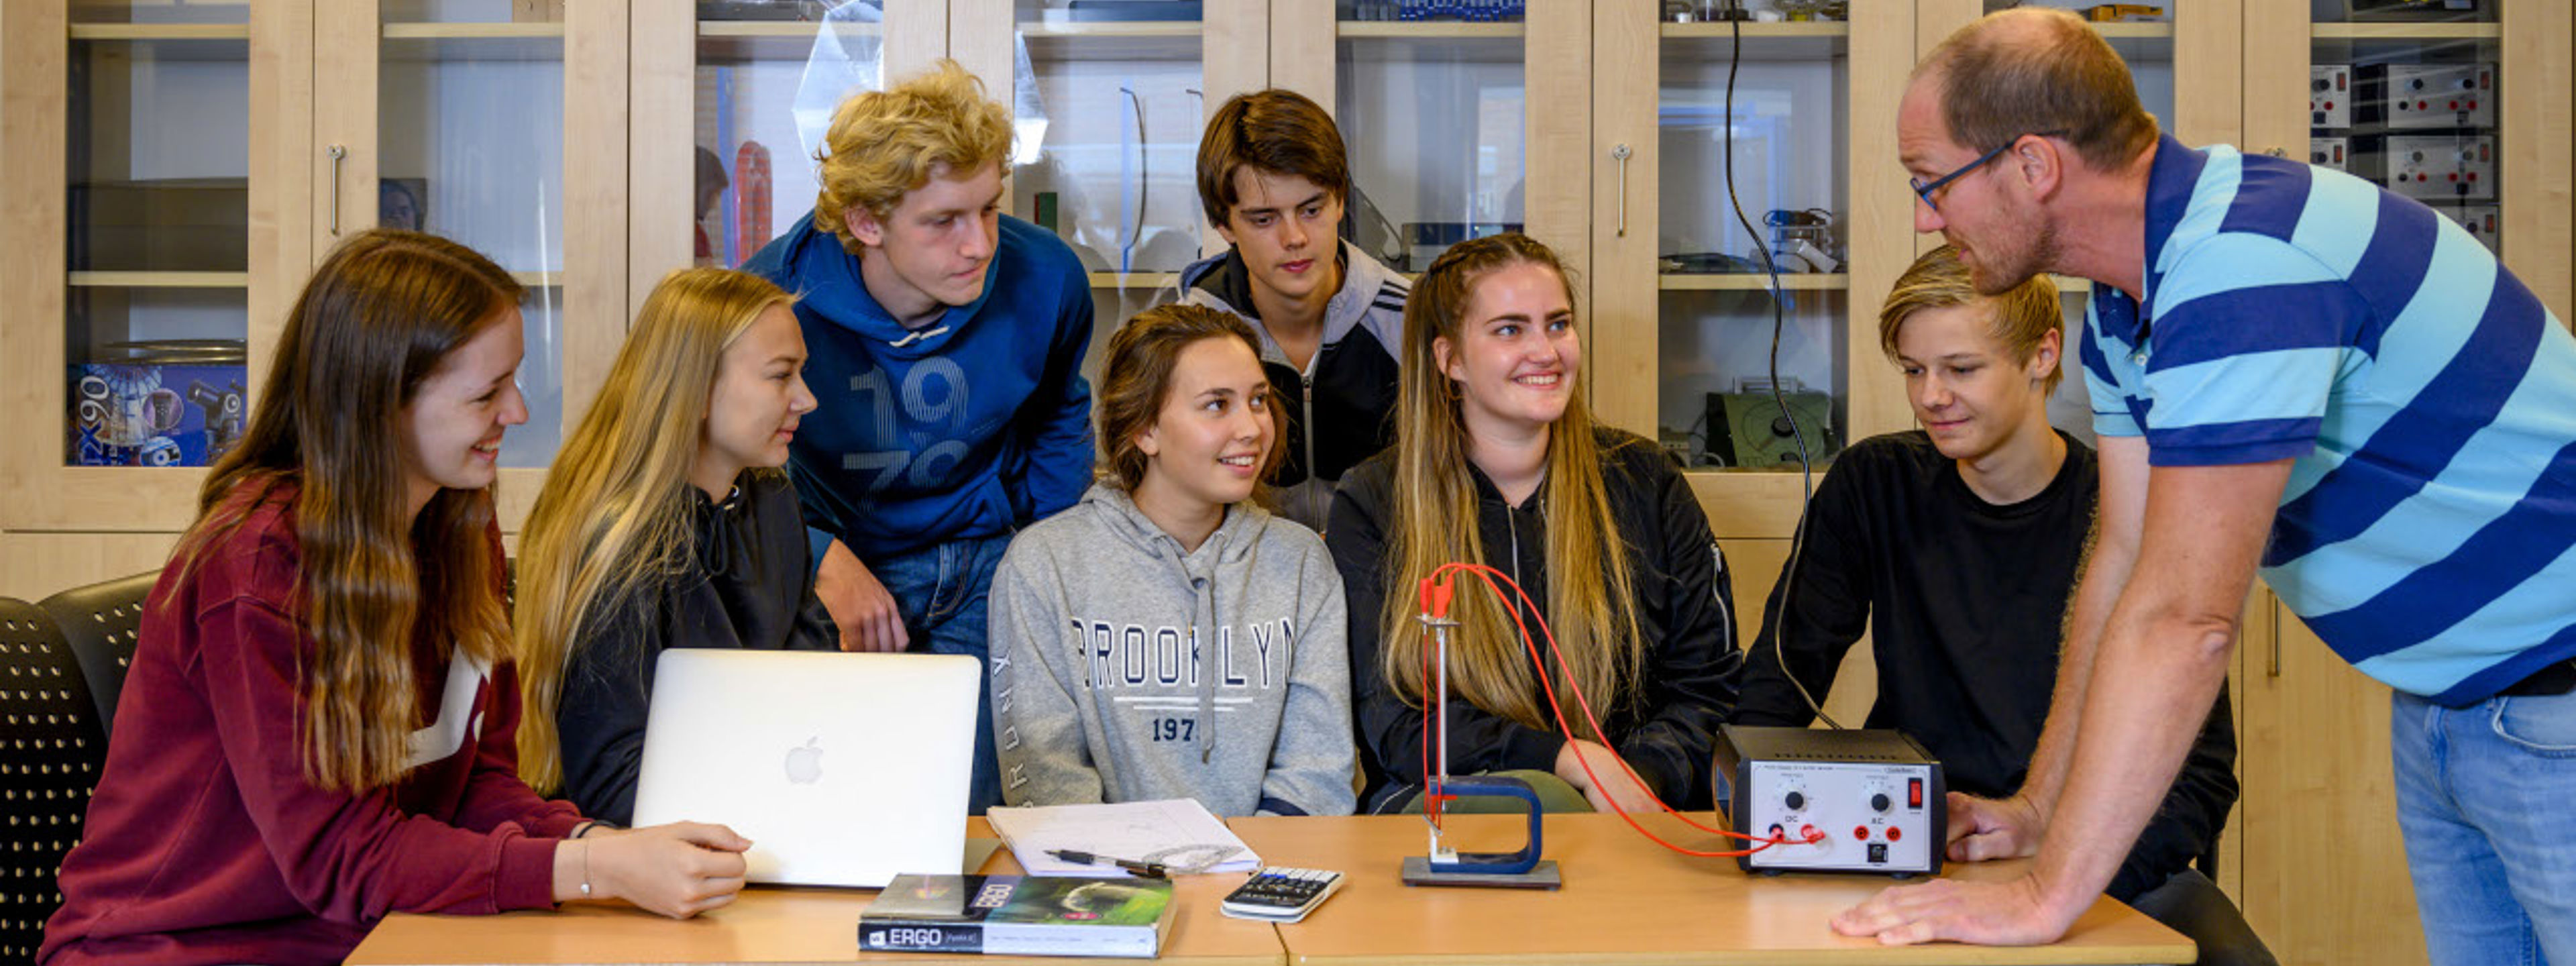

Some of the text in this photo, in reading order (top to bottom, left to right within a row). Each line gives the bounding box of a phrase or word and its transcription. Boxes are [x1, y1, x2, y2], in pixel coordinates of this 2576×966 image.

[850, 356, 969, 449] 19
[1152, 718, 1201, 743] 197
[890, 928, 942, 946] ERGO
